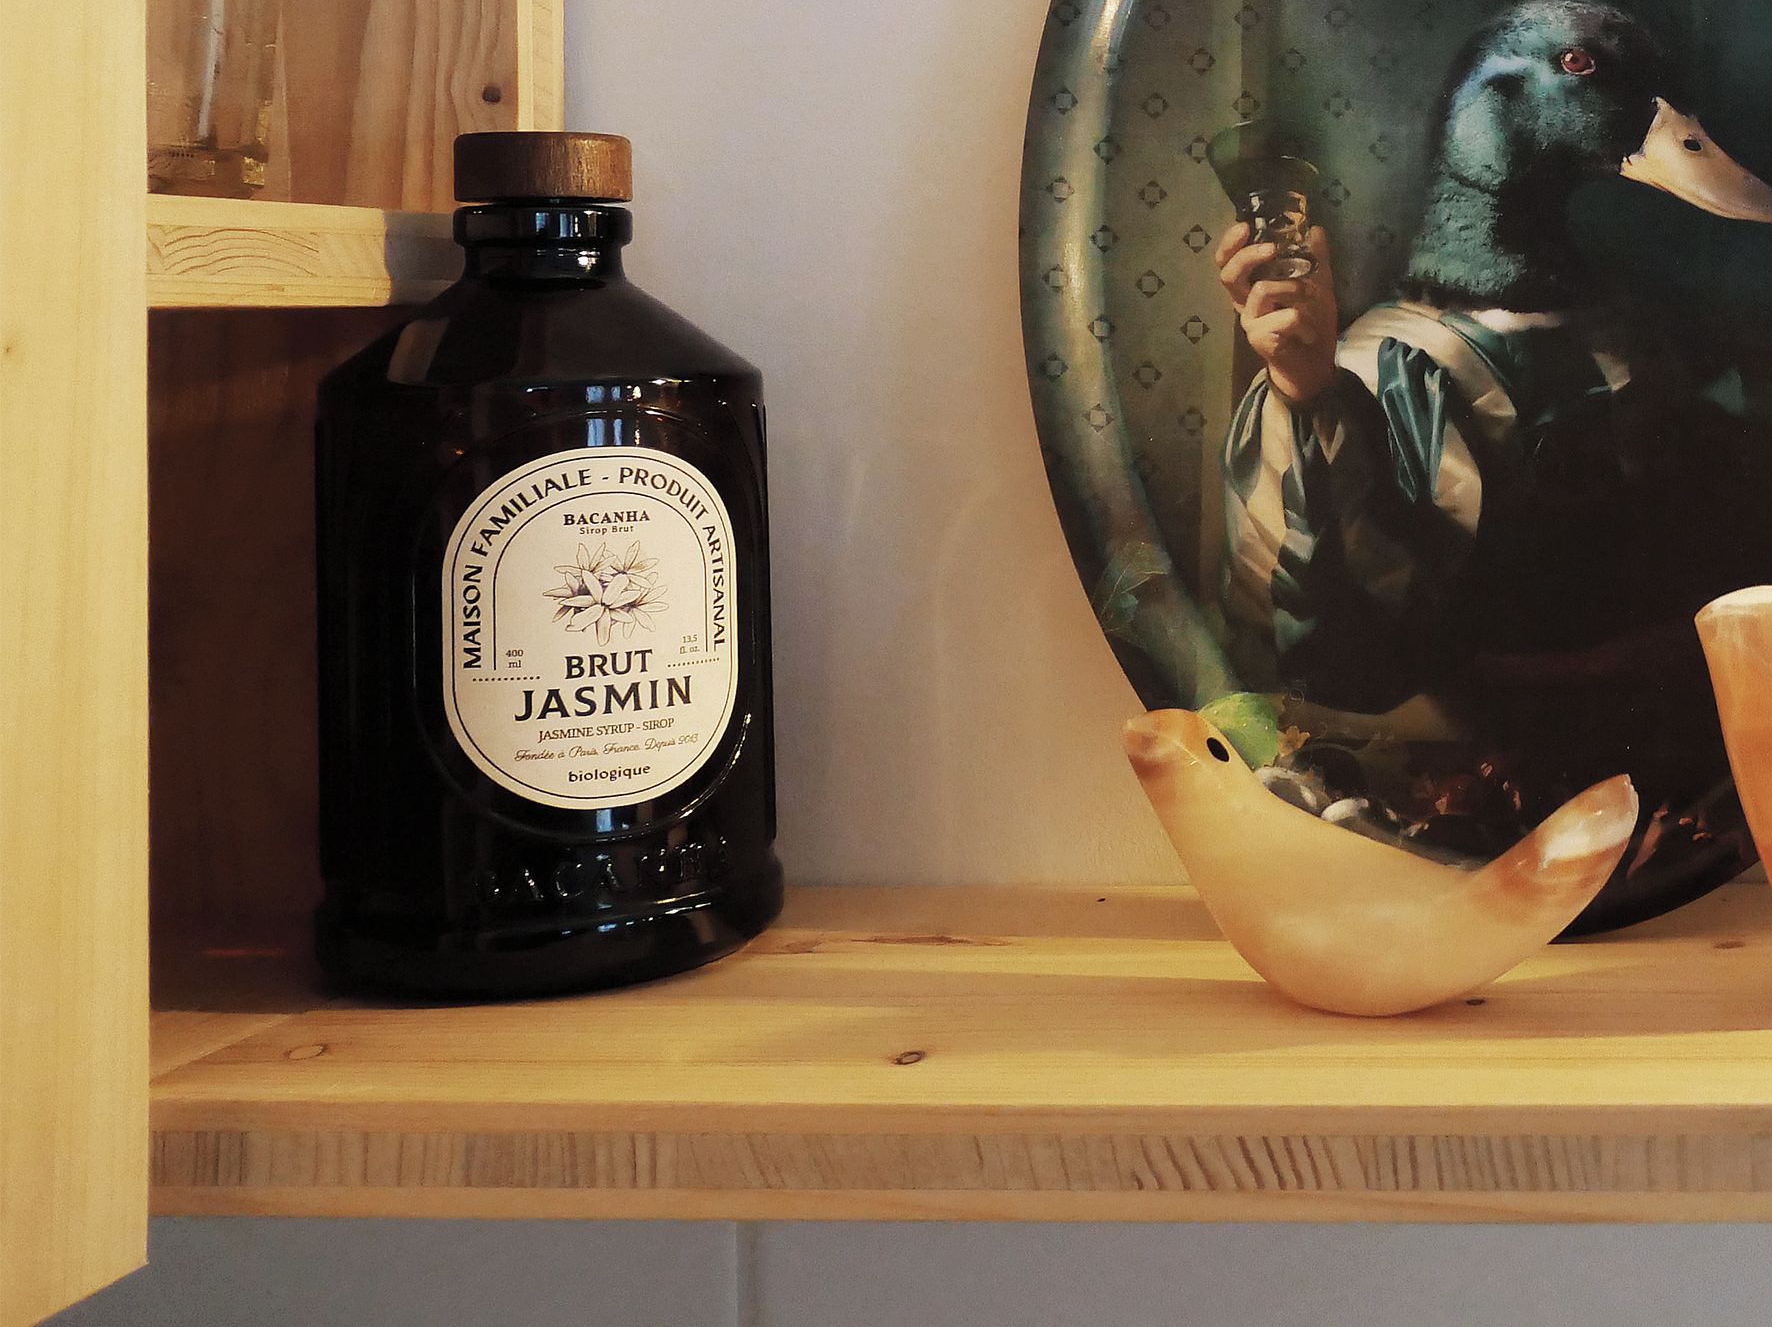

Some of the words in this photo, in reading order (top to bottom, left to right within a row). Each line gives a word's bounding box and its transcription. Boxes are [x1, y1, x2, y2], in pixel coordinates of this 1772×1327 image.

[619, 467, 709, 520] PRODUIT
[470, 468, 592, 557] FAMILIALE
[563, 510, 650, 525] BACANHA
[579, 527, 608, 536] Sirop
[611, 525, 634, 533] Brut
[702, 525, 726, 652] ARTISANAL
[463, 565, 483, 669] MAISON
[505, 649, 524, 658] 400
[508, 660, 522, 669] ml
[565, 649, 653, 680] BRUT
[514, 675, 692, 722] JASMIN
[538, 727, 594, 743] JASMINE
[596, 723, 634, 736] SYRUP
[642, 717, 675, 731] SIROP
[644, 737, 676, 752] Depuis
[568, 765, 651, 782] biologique
